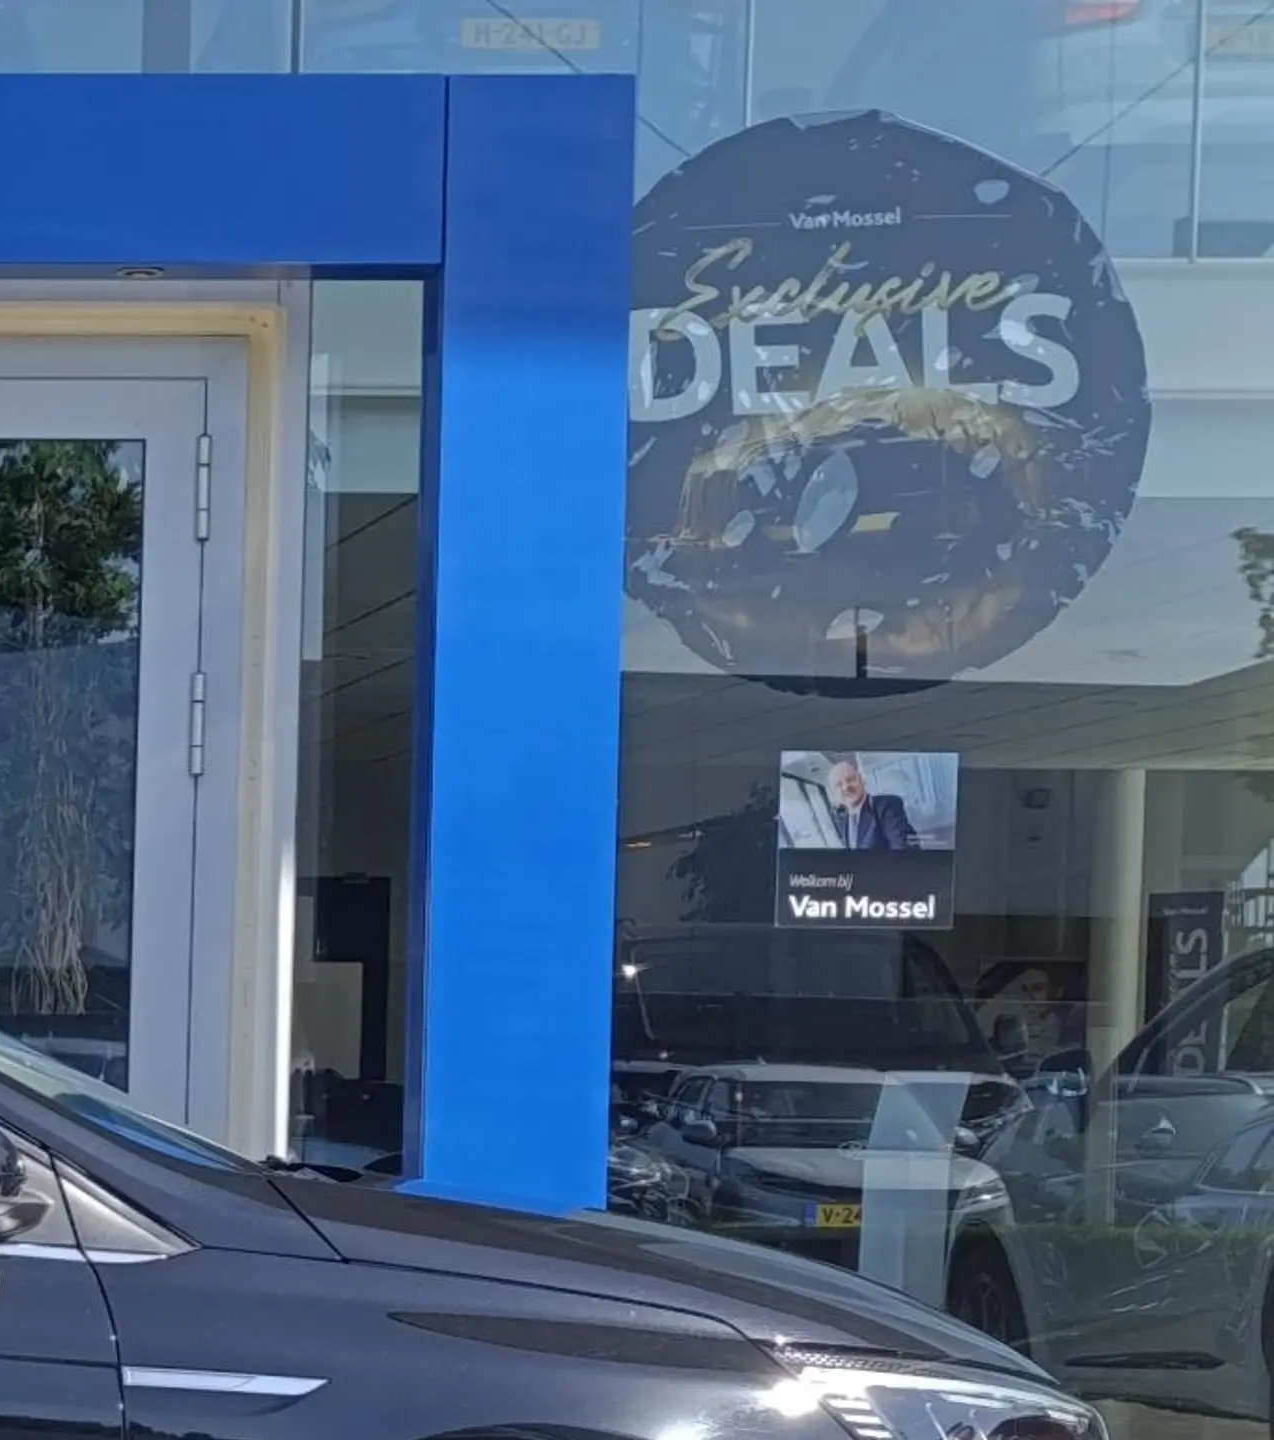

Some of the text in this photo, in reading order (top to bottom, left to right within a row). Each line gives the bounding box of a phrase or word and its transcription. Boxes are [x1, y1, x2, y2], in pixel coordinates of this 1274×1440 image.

[788, 207, 902, 230] Van Mossel
[628, 292, 1080, 423] DEALS
[788, 894, 936, 920] Van Mossel
